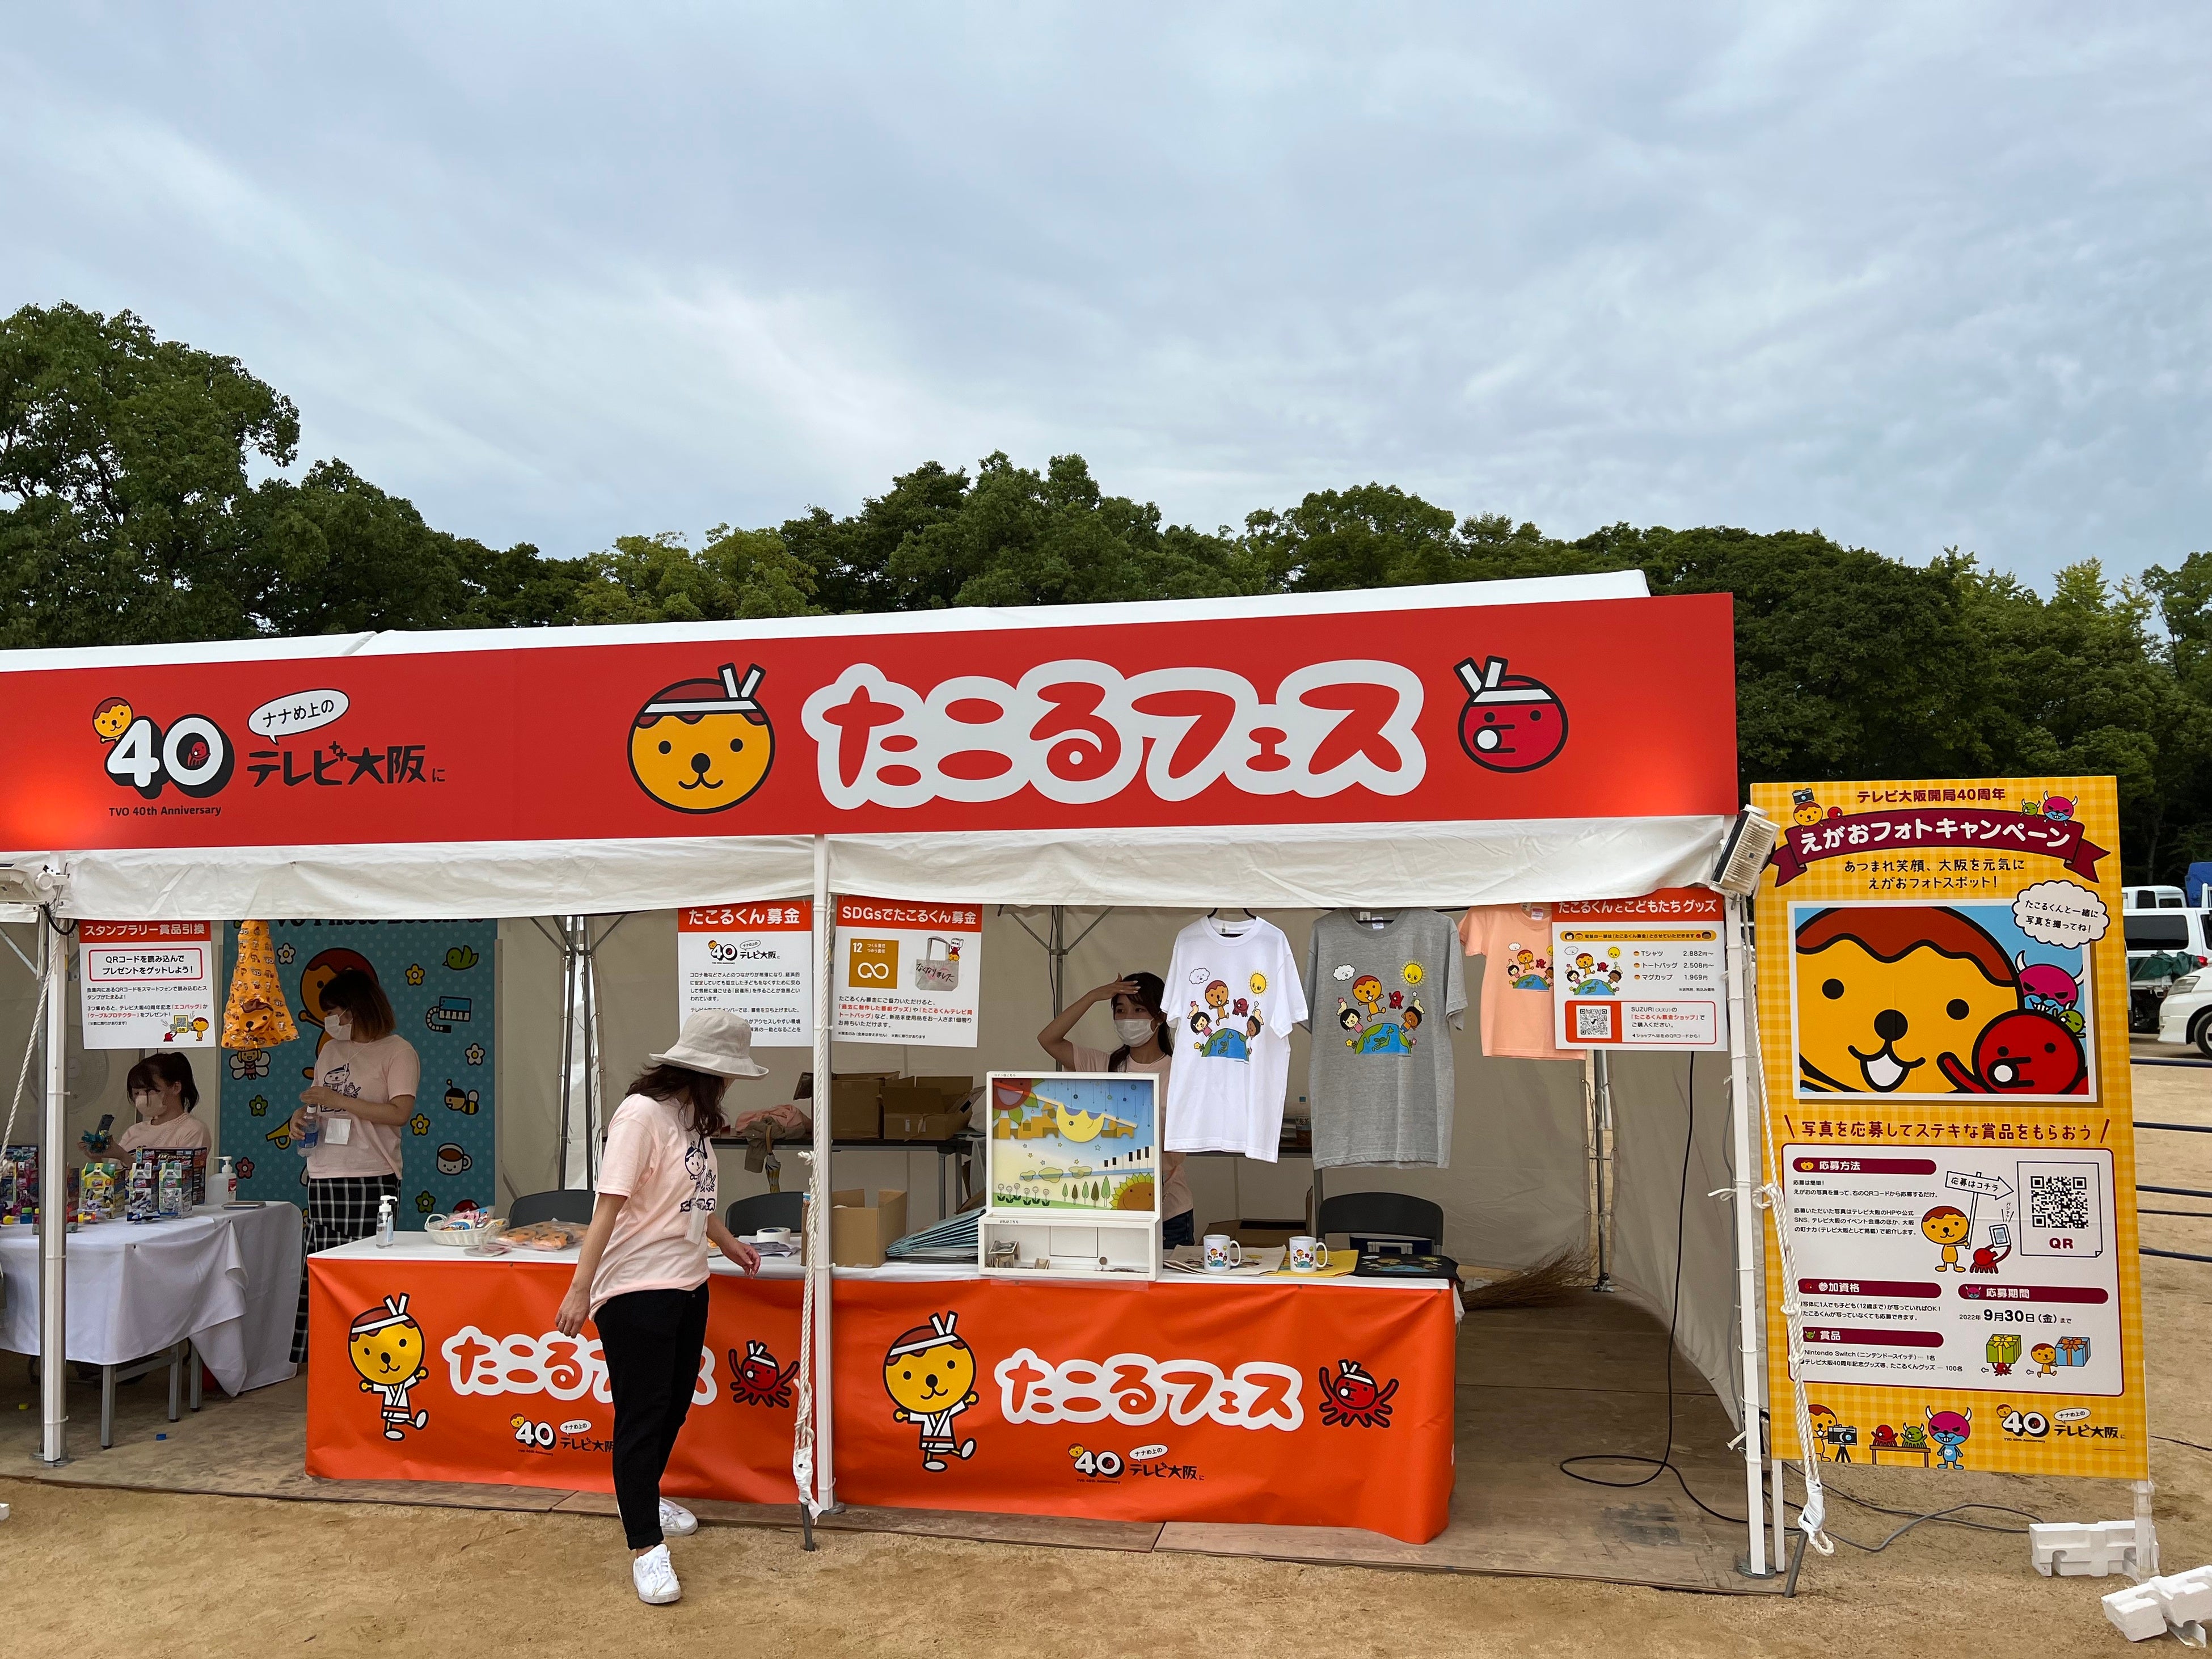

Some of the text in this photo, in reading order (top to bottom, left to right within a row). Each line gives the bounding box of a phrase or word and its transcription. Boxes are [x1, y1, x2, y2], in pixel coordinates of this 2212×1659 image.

[263, 699, 334, 728] ナナめ上の
[804, 662, 1422, 807] たこるフェス
[105, 715, 234, 799] 40
[1856, 787, 2006, 804] テレビ大阪開局40周年
[109, 805, 222, 817] TVO 40th Anniversary
[1800, 817, 2071, 854] えがおフォトキャンペーン
[1844, 858, 2025, 873] あつまれ笑顔、大阪を元気に
[1868, 875, 1998, 890] えがおフォトスポット！
[1558, 899, 1717, 914] たこるくんとこどもたちグッズ
[2024, 900, 2100, 919] たこるくんと一緒に
[689, 907, 800, 925] たこるくん募金
[842, 906, 977, 925] SDGsでたこるくん募金
[85, 923, 205, 936] スタンプラリー賞品引換
[2025, 915, 2092, 934] 写真を撮ってね！
[711, 944, 738, 961] 40
[852, 942, 863, 953] 12
[105, 955, 185, 964] QRコードを読み込んで
[102, 965, 193, 975] プレゼントをゲットしよう！
[916, 963, 955, 982] なくなりました
[839, 996, 935, 1005] たこるくん募金にご協力いただけると、
[1801, 1120, 2092, 1140] 写真を応募してステキな賞品をもらおう
[1819, 1160, 1861, 1171] 応募方法
[1951, 1177, 1998, 1192] 応募はコチラ
[2049, 1238, 2074, 1249] QR
[1818, 1282, 1860, 1294] 参加資格
[1986, 1288, 2030, 1299] 応募期間
[1820, 1331, 1841, 1341] 賞品
[995, 1349, 1302, 1429] たこるフェス
[2002, 1411, 2050, 1438] 40
[515, 1420, 557, 1450] 40
[1134, 1448, 1163, 1457] ナナめ上の
[1074, 1450, 1125, 1478] 40
